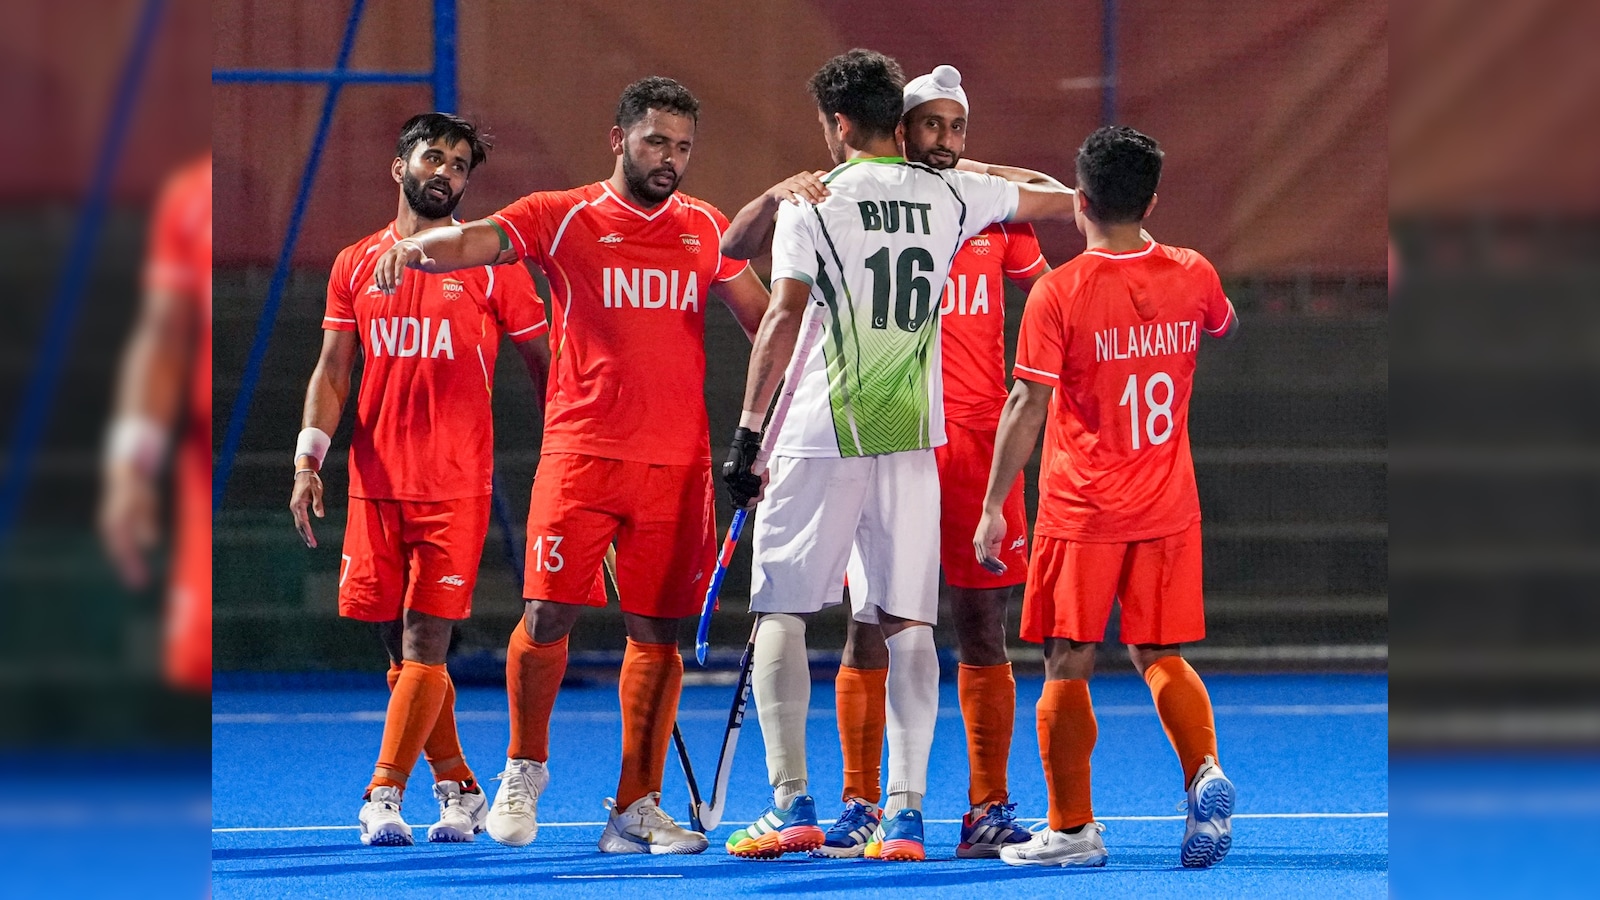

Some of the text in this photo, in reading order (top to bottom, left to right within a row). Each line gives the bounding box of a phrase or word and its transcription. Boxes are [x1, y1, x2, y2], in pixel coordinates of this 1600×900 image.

[857, 200, 932, 235] BUTT
[681, 238, 701, 247] INDIA
[969, 238, 991, 247] INDIA
[442, 283, 464, 293] INDIA
[602, 267, 699, 313] INDIA
[864, 246, 935, 333] 16
[940, 273, 989, 316] DIA
[369, 316, 455, 361] INDIA
[1094, 320, 1197, 363] NILAKANTA
[1118, 371, 1175, 451] 18
[532, 535, 564, 573] 13
